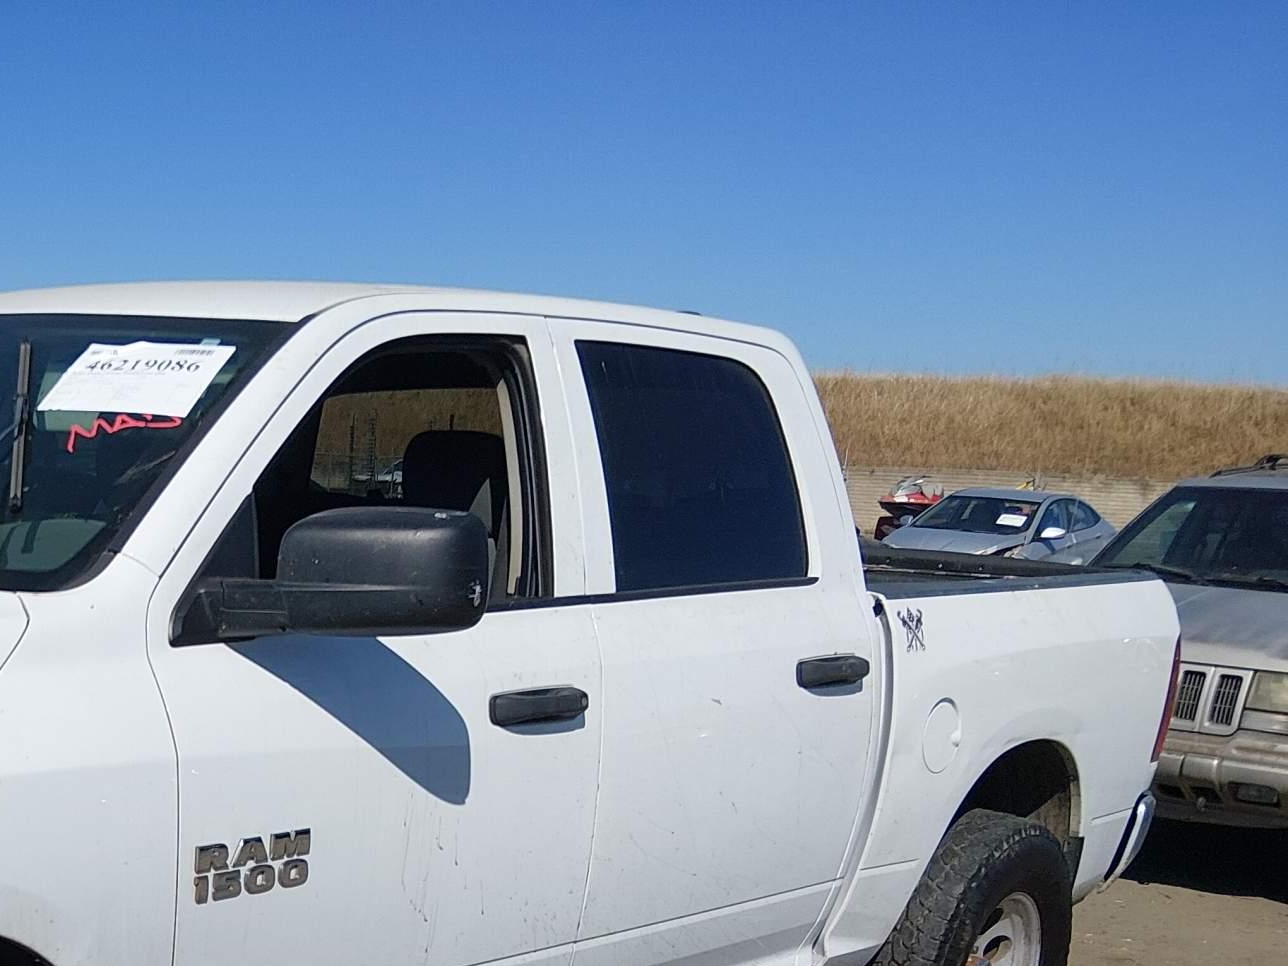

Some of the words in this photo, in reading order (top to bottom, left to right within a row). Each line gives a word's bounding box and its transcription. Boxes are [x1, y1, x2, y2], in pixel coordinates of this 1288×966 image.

[86, 359, 202, 373] 46219086
[194, 828, 311, 875] RAM
[193, 858, 309, 905] 1500
